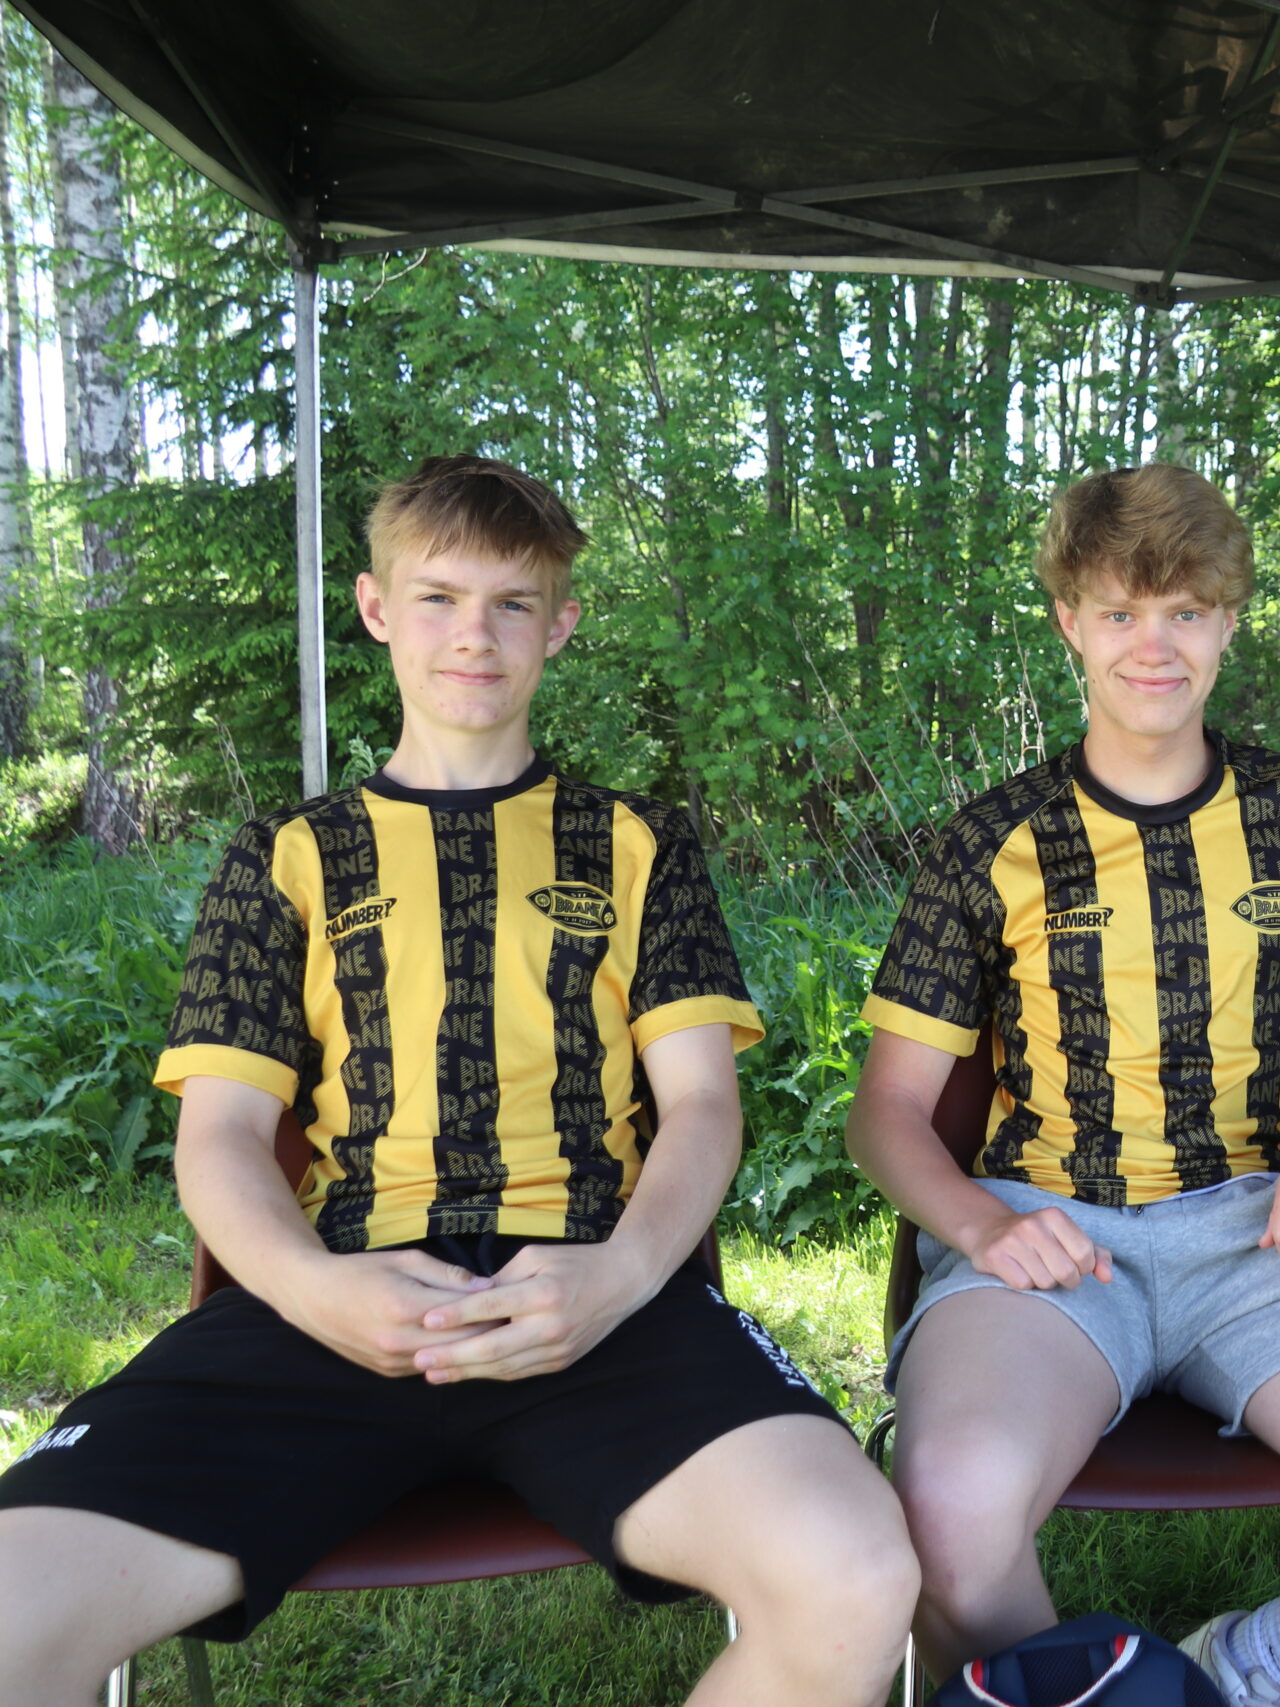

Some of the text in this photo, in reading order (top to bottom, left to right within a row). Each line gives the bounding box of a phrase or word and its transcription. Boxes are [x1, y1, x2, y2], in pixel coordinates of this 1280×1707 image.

[879, 958, 938, 1008] BRANE
[901, 936, 977, 988] BRANE
[197, 970, 273, 1014] BRANE
